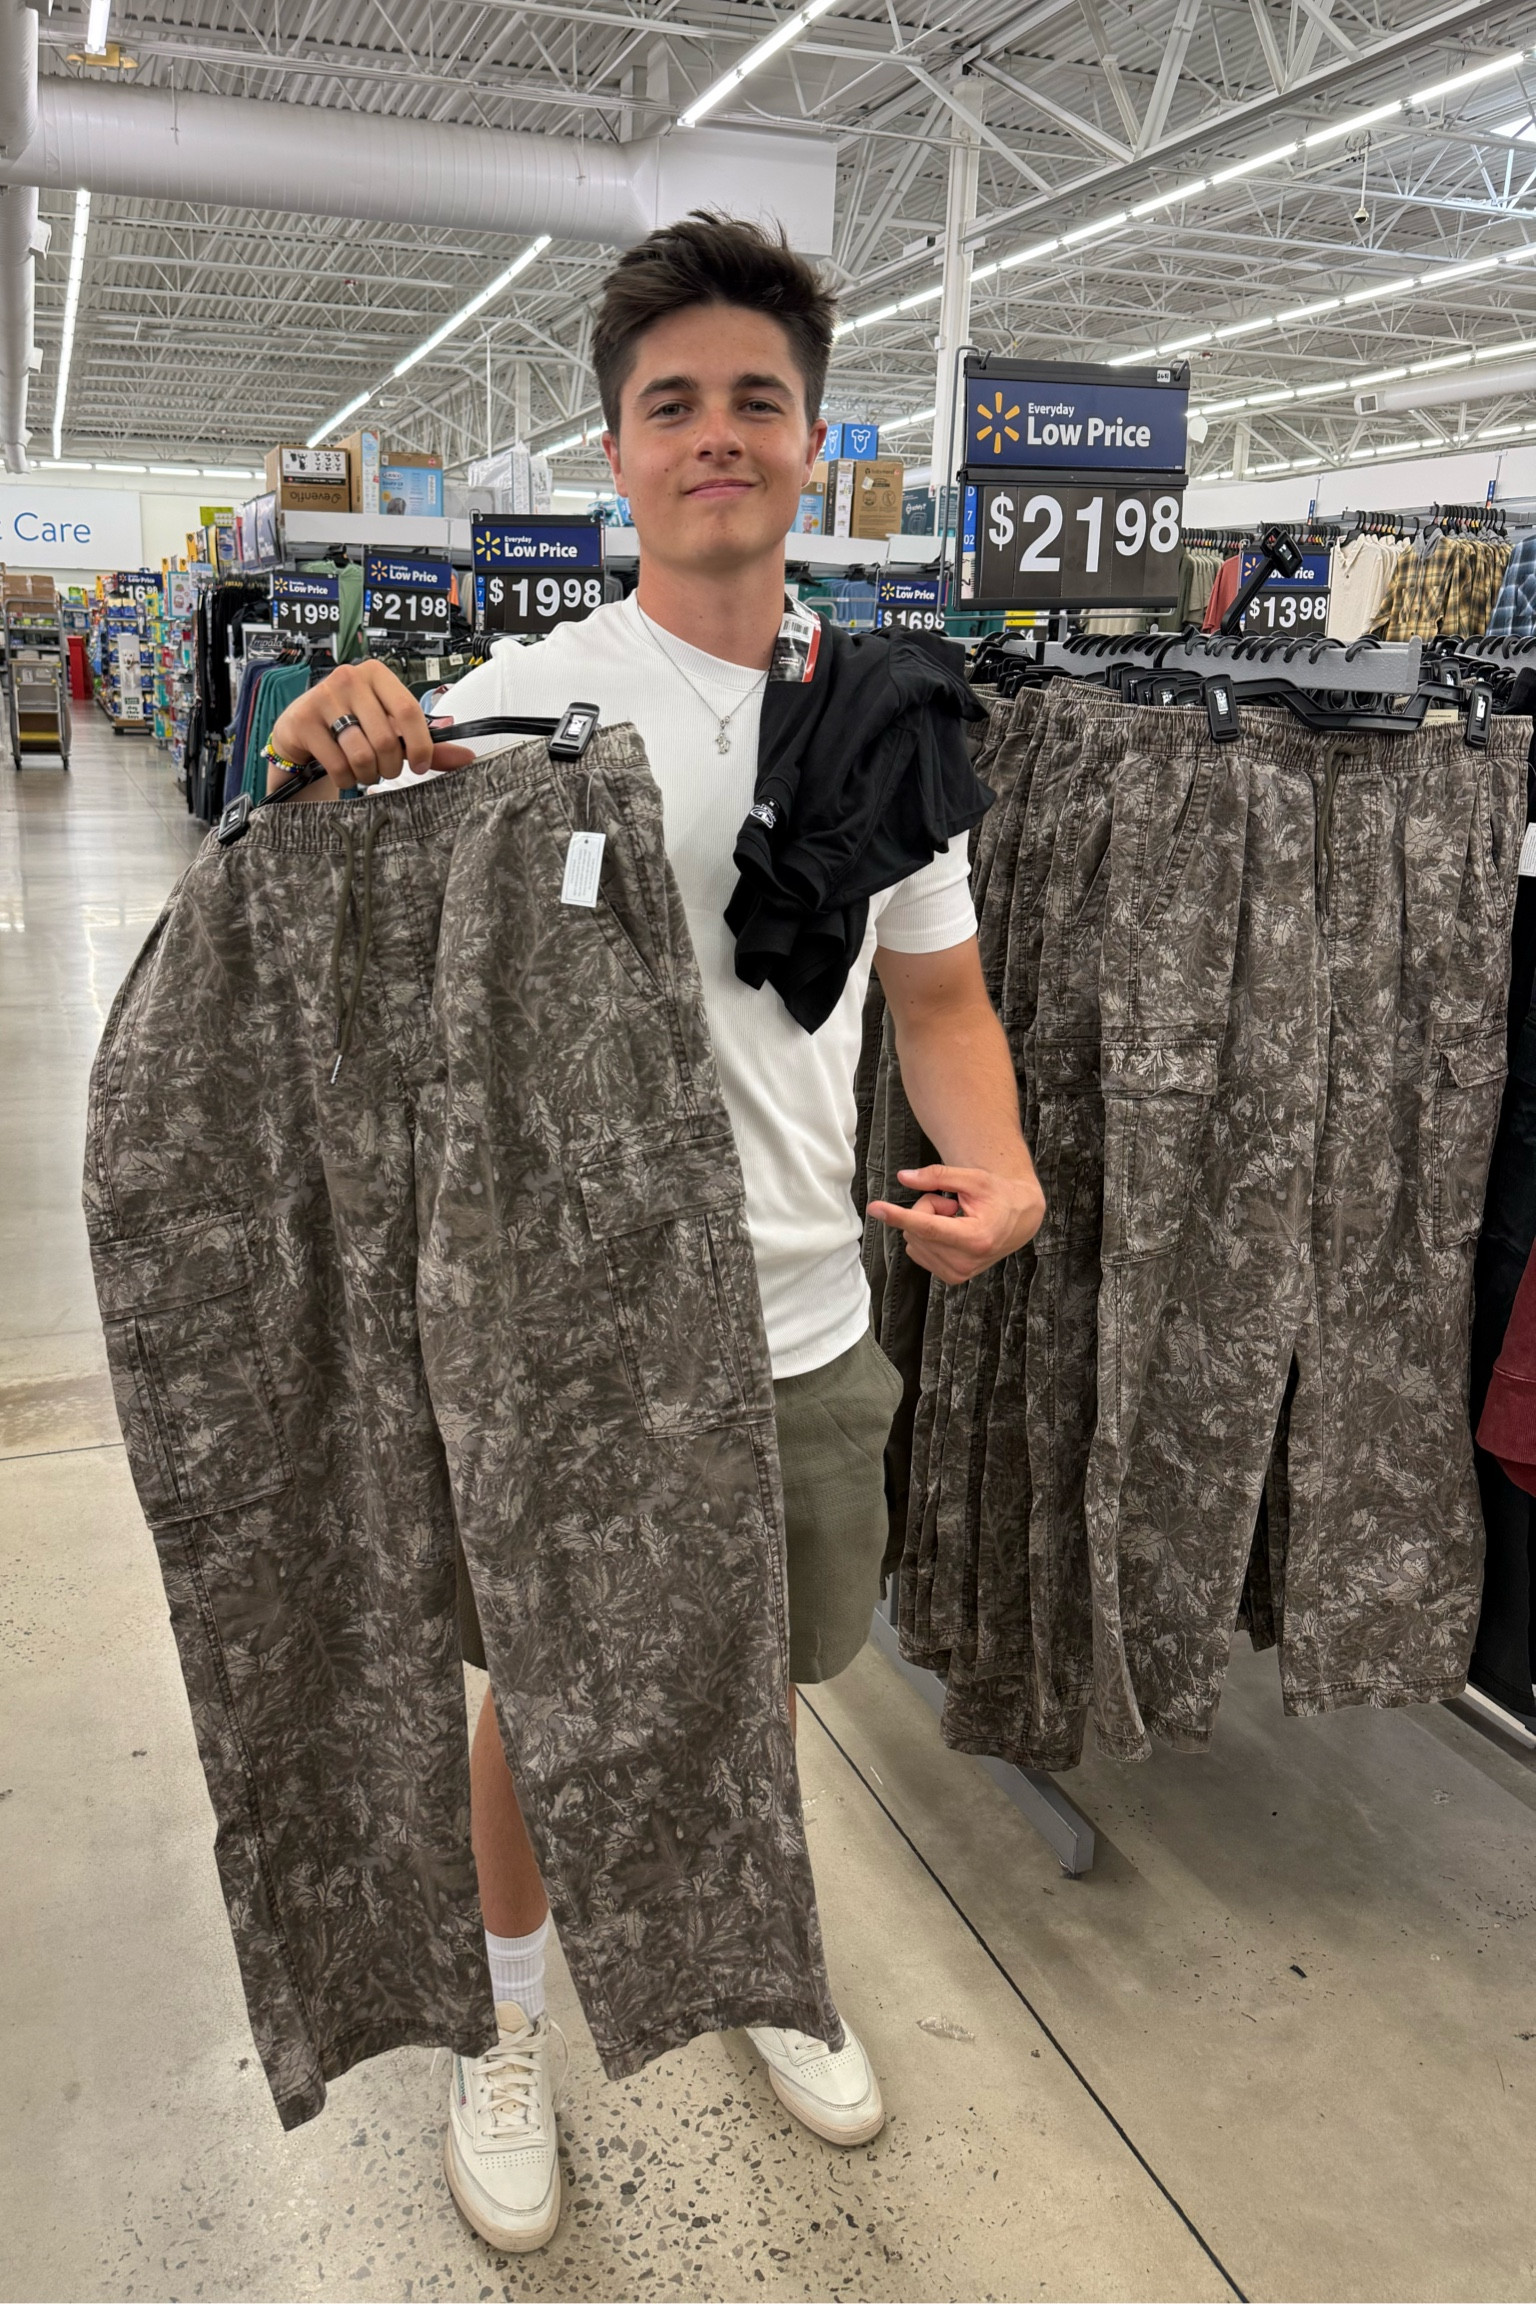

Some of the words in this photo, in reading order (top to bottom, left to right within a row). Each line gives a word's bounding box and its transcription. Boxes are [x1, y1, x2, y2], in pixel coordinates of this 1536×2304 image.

[1028, 403, 1075, 417] Everyday
[1027, 416, 1082, 446] Low
[1087, 417, 1151, 447] Price
[14, 512, 91, 543] Care
[504, 536, 532, 544] Everyday
[504, 543, 537, 557] Low
[540, 542, 578, 558] Price
[390, 570, 411, 580] Low
[412, 570, 438, 583] Price
[289, 585, 307, 594] Low
[308, 586, 328, 595] Price
[896, 589, 913, 599] Low
[914, 589, 935, 600] Price
